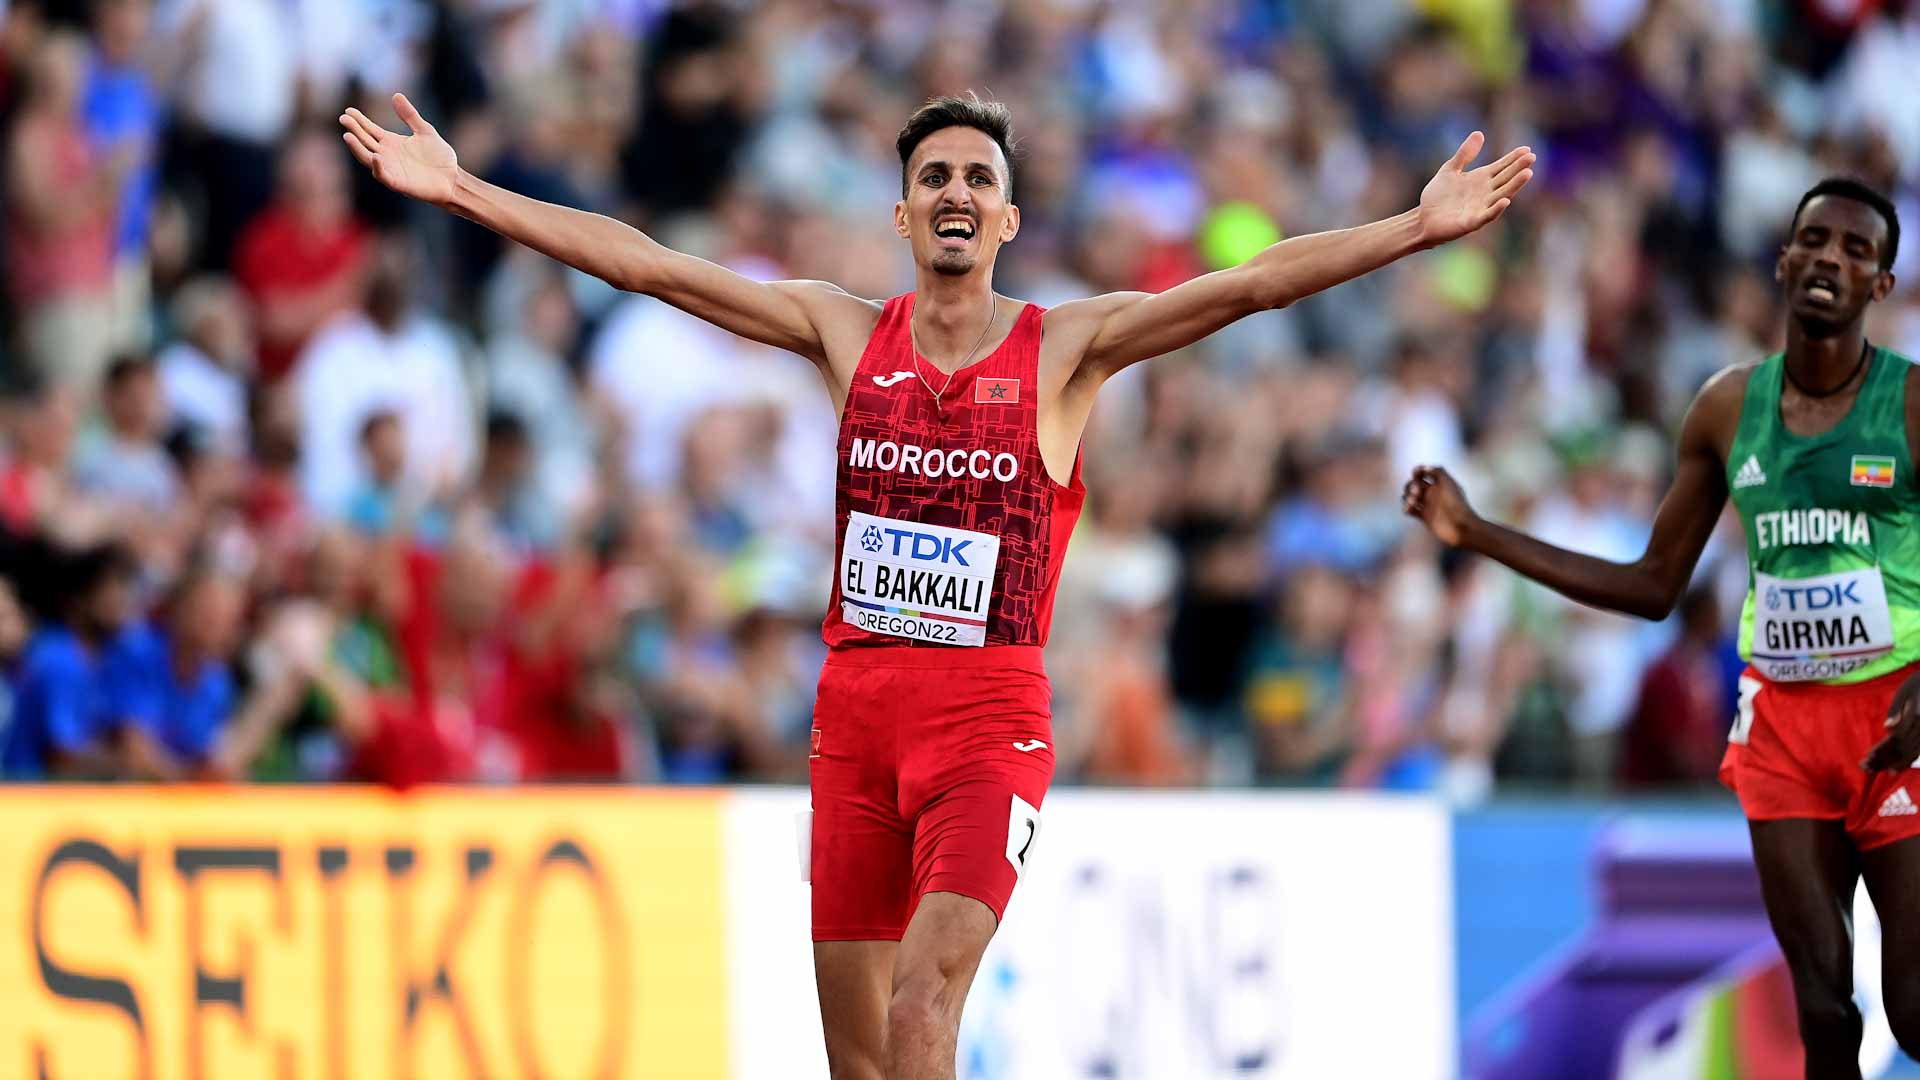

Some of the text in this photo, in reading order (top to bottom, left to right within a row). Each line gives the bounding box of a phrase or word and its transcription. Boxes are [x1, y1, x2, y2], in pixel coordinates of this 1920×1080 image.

[850, 438, 1018, 482] MOROCCO
[884, 529, 973, 566] TDK
[1755, 508, 1870, 549] ETHIOPIA
[847, 559, 984, 613] EL BAKKALI
[1780, 580, 1862, 611] TDK
[858, 611, 957, 642] OREGON22
[1766, 616, 1870, 650] GIRMA
[30, 838, 636, 1080] SEIKO
